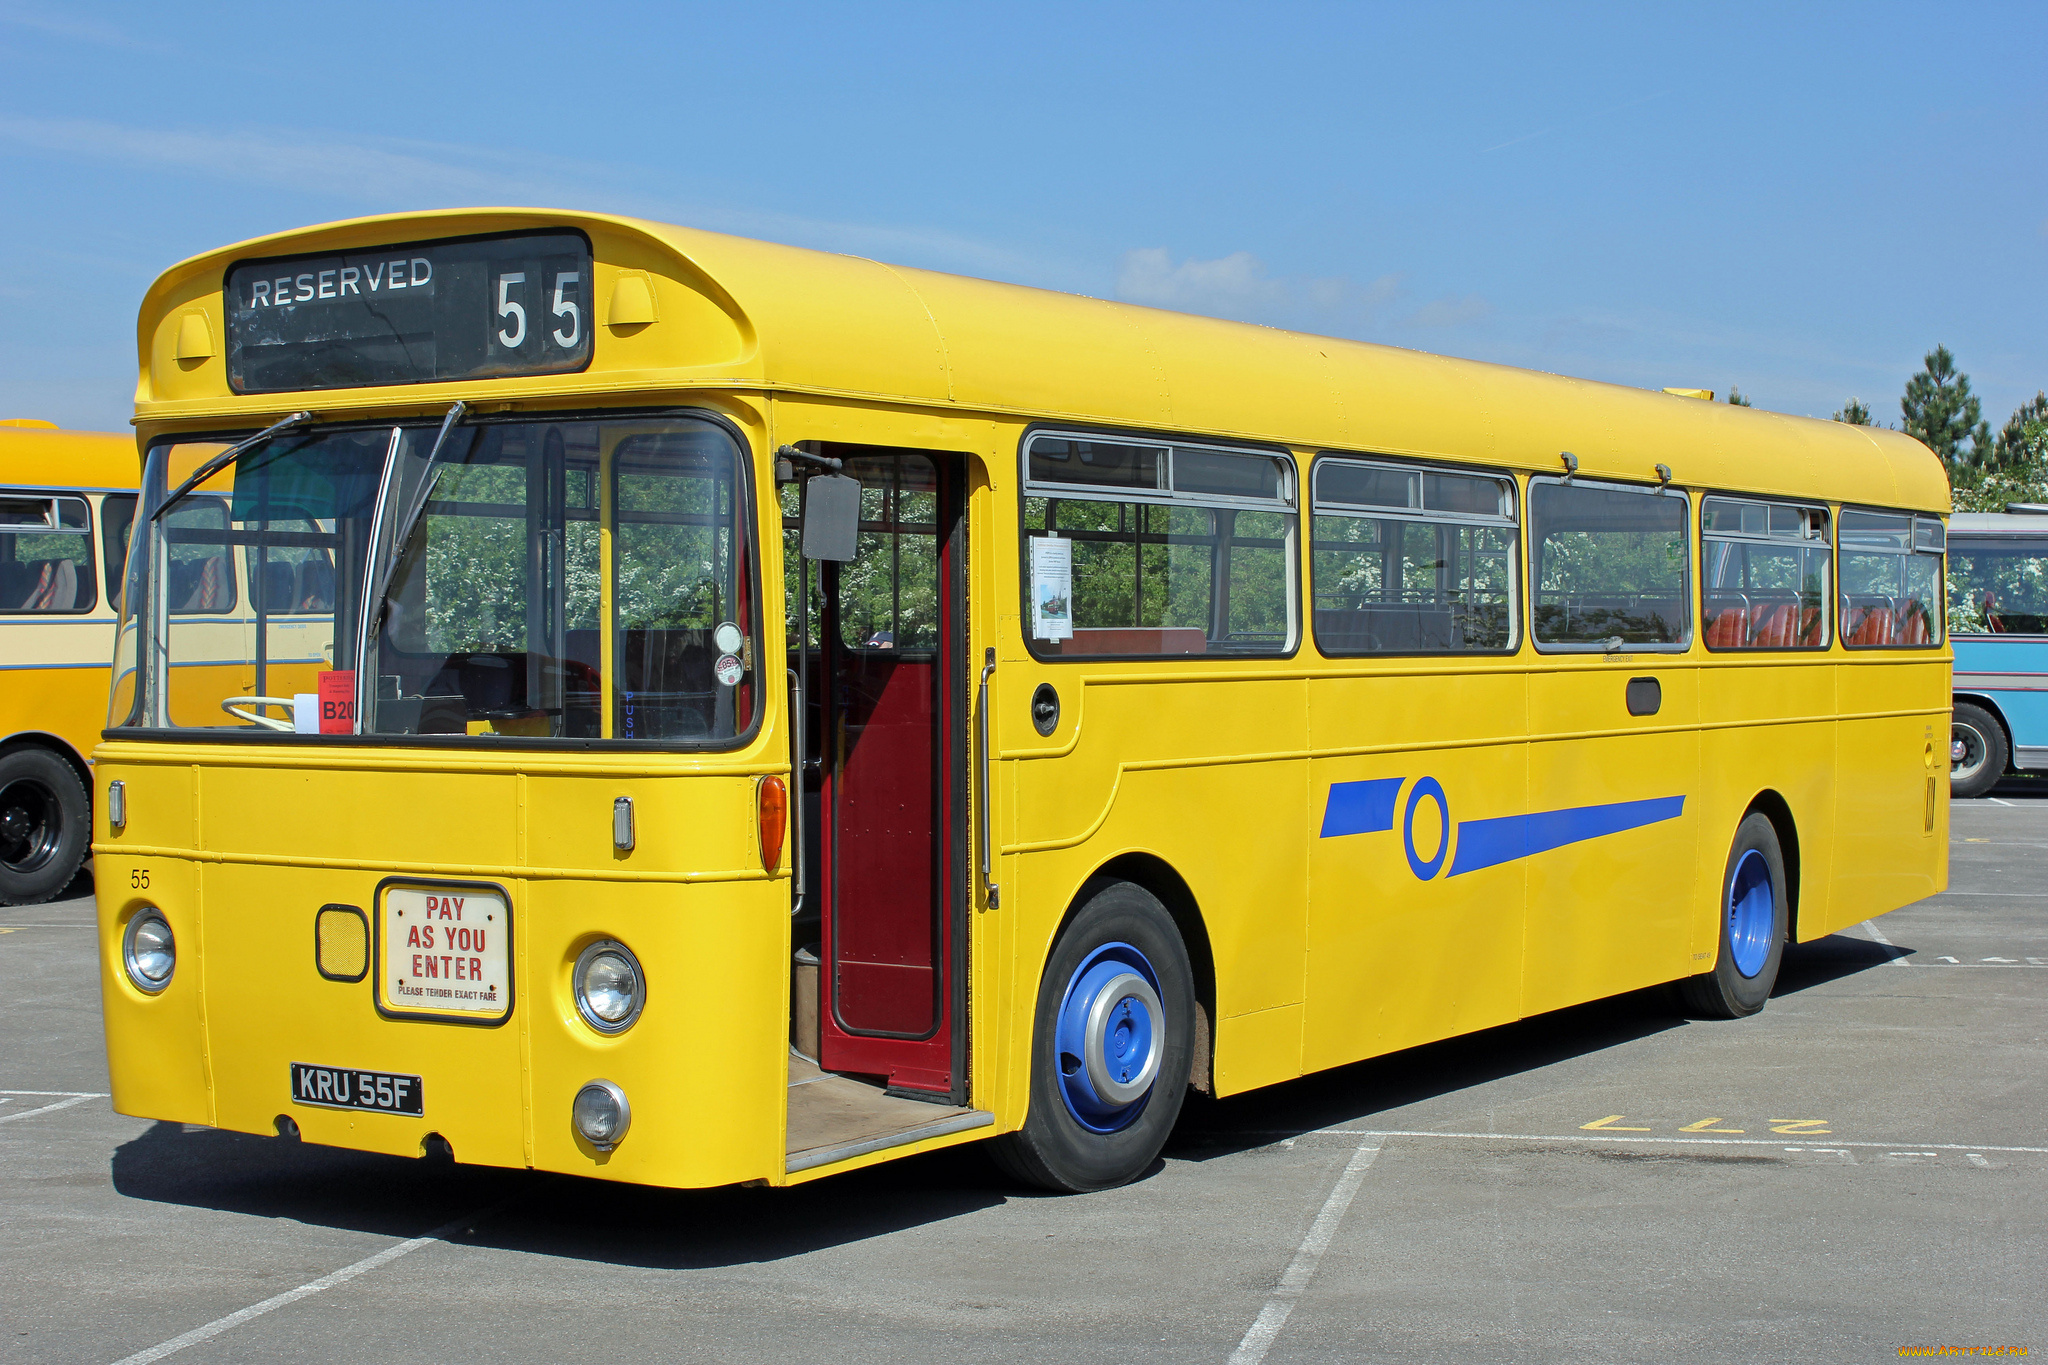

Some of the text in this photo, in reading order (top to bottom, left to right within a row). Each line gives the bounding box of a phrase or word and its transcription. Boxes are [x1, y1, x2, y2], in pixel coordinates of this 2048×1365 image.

[251, 257, 433, 309] RESERVED
[626, 692, 634, 739] PUSH
[131, 869, 150, 889] 55
[426, 896, 465, 921] PAY
[407, 925, 486, 953] AS YOU
[412, 954, 482, 981] ENTER
[398, 985, 497, 1002] PLEASE TENDER EXACT FARE
[300, 1067, 411, 1109] KRU 55F
